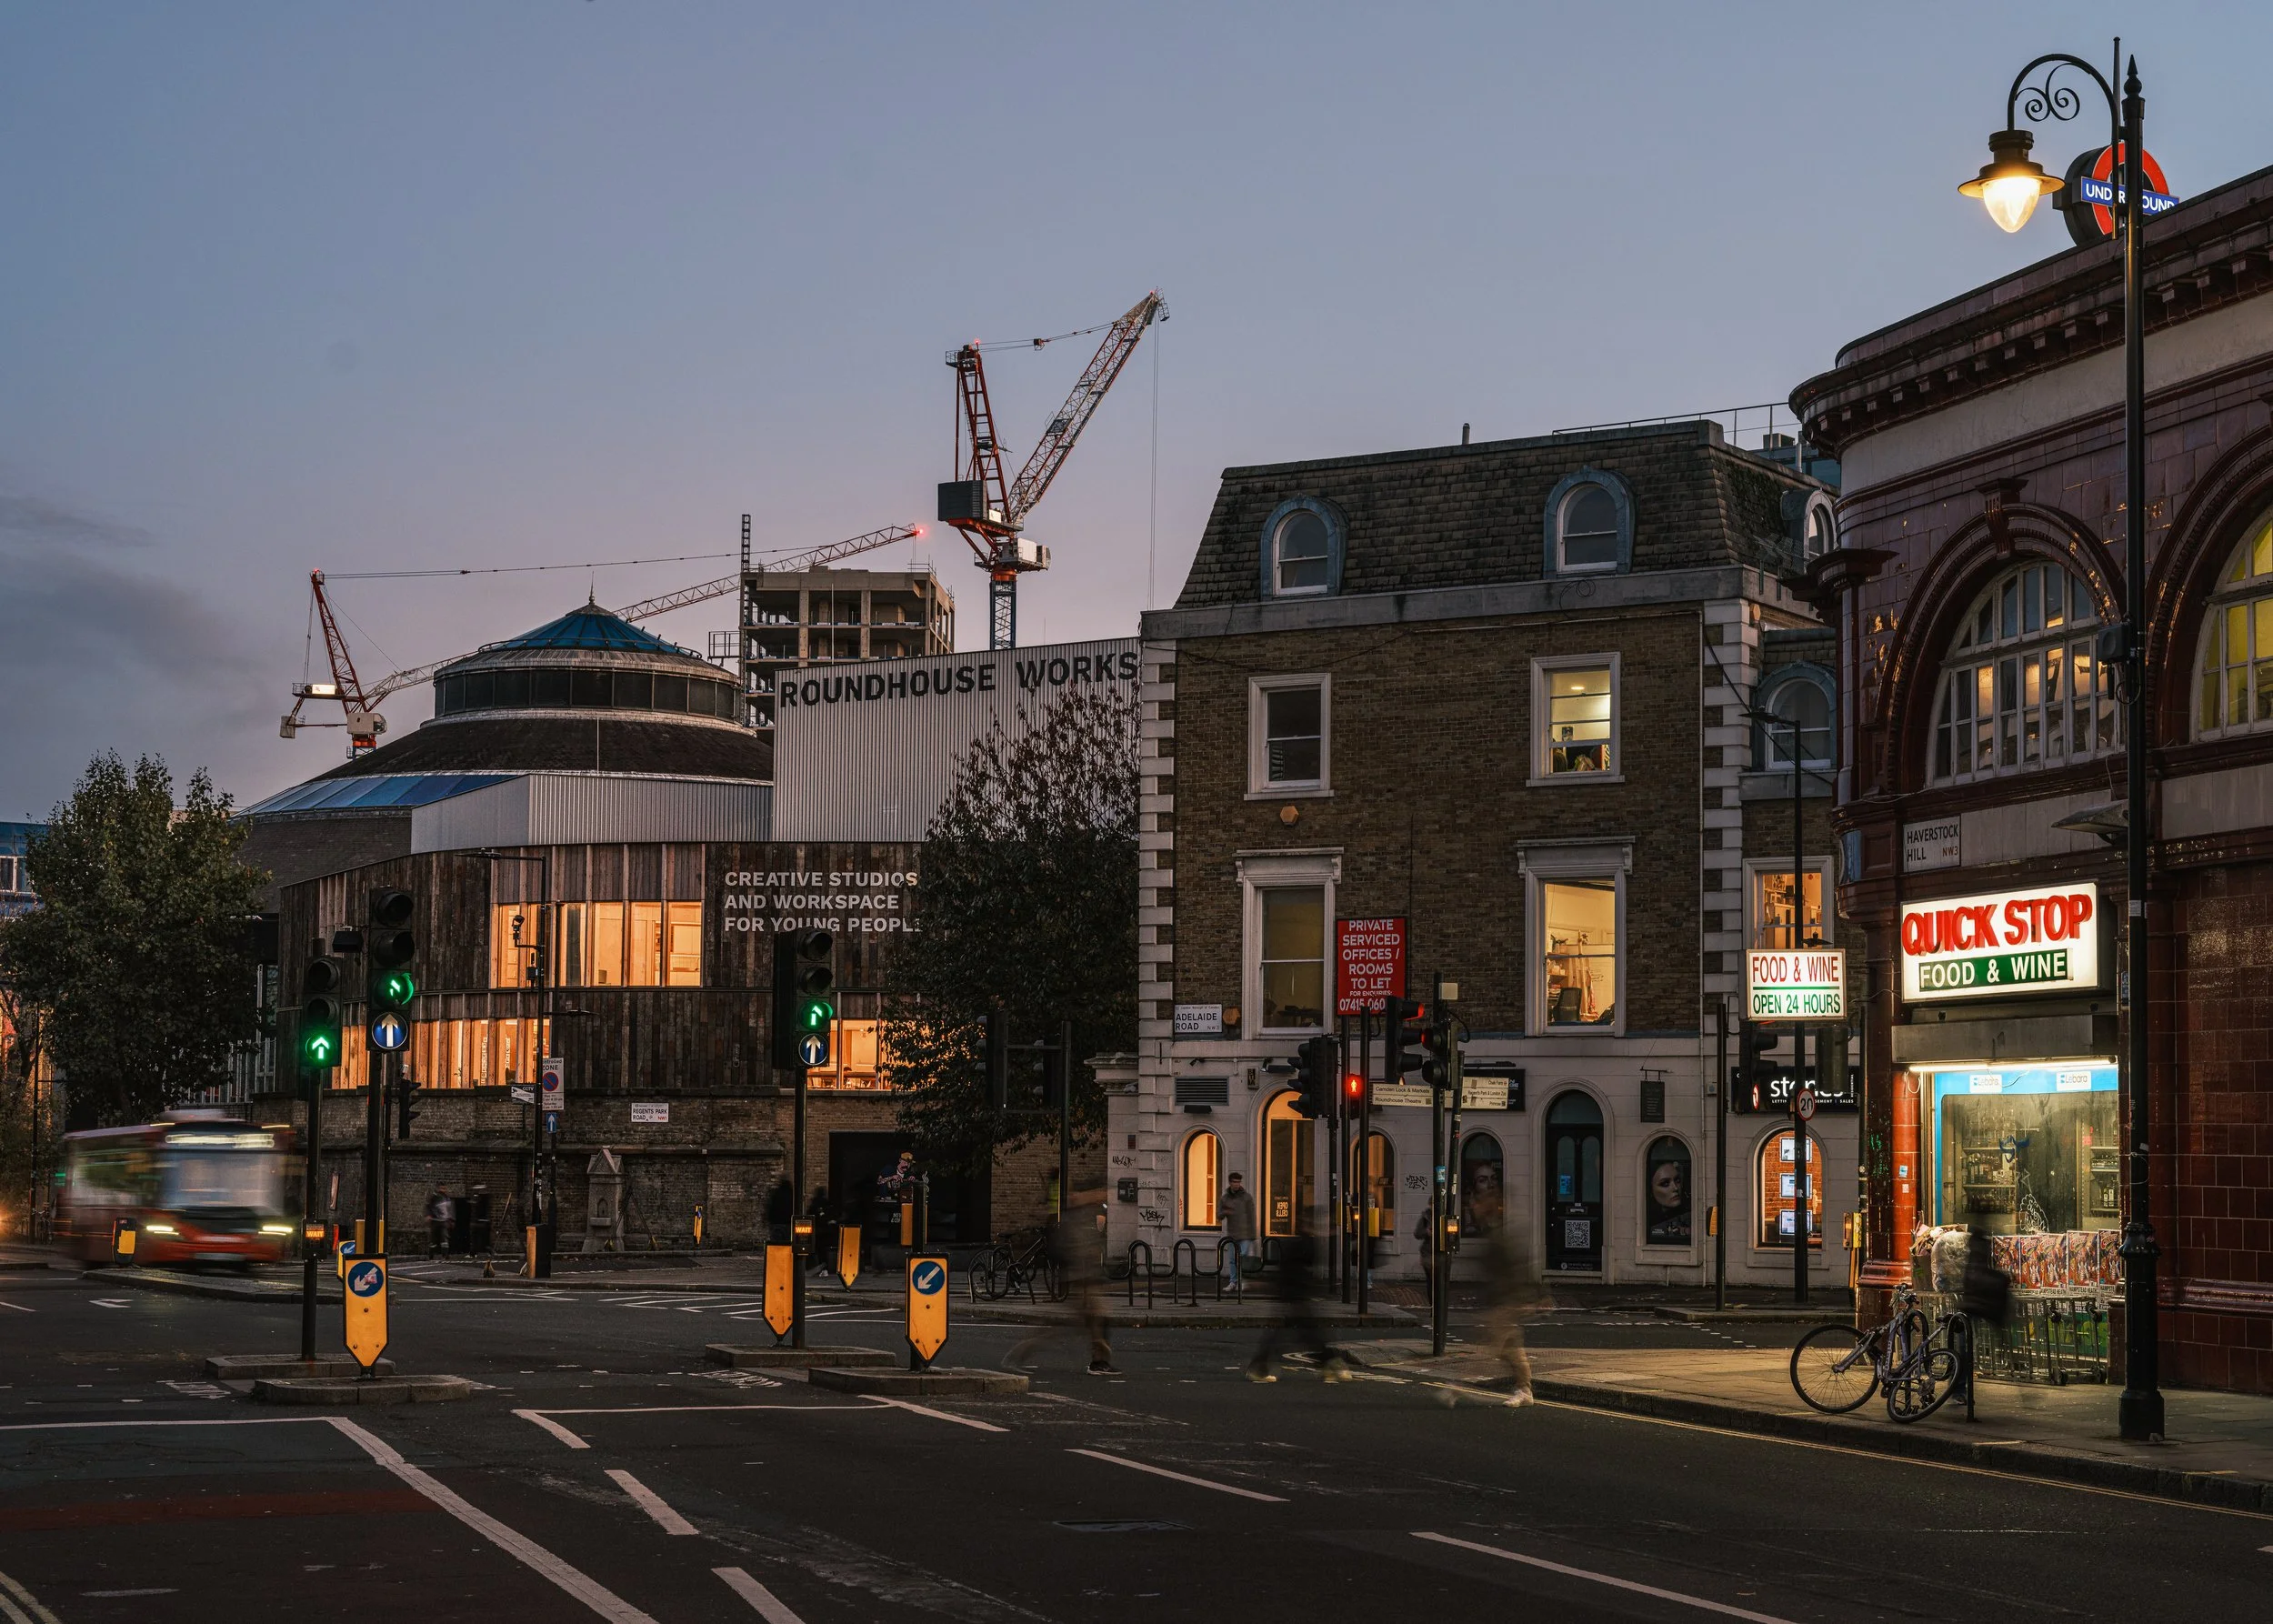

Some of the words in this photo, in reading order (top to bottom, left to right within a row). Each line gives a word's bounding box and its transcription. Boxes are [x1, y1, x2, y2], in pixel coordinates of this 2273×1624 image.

[2086, 183, 2175, 212] UNDROUND
[780, 664, 996, 707] ROUNDHOUSE
[1016, 651, 1137, 688] WORKS
[1907, 824, 1958, 844] HAVERSTOCK
[1907, 847, 1927, 862] HILL
[725, 872, 823, 887] CREATIVE
[828, 872, 918, 887] STUDIOS
[725, 895, 766, 909] AND
[773, 895, 899, 909] WORKSPACE
[725, 917, 764, 932] FOR
[770, 917, 840, 932] YOUNG
[1348, 919, 1394, 931] PRIVATE
[1902, 904, 1999, 957] QUICK
[2004, 894, 2093, 946] STOP
[1342, 934, 1400, 946] SERVICED
[1342, 948, 1392, 960] OFFICES
[1396, 948, 1399, 959] /
[1348, 963, 1394, 975] ROOMS
[1752, 957, 1787, 983] FOOD
[1793, 957, 1801, 982] &
[1807, 957, 1838, 982] WINE
[1920, 962, 1975, 988] FOOD
[1987, 958, 2000, 983] &
[2011, 952, 2066, 980] WINE
[1351, 978, 1367, 989] TO
[1370, 977, 1391, 988] LET
[1339, 998, 1365, 1011] 07415
[1753, 994, 1781, 1014] OPEN
[1787, 995, 1798, 1013] 24
[1804, 994, 1840, 1013] HOURS
[2065, 1074, 2088, 1084] Lebara
[1800, 1098, 1813, 1110] 20
